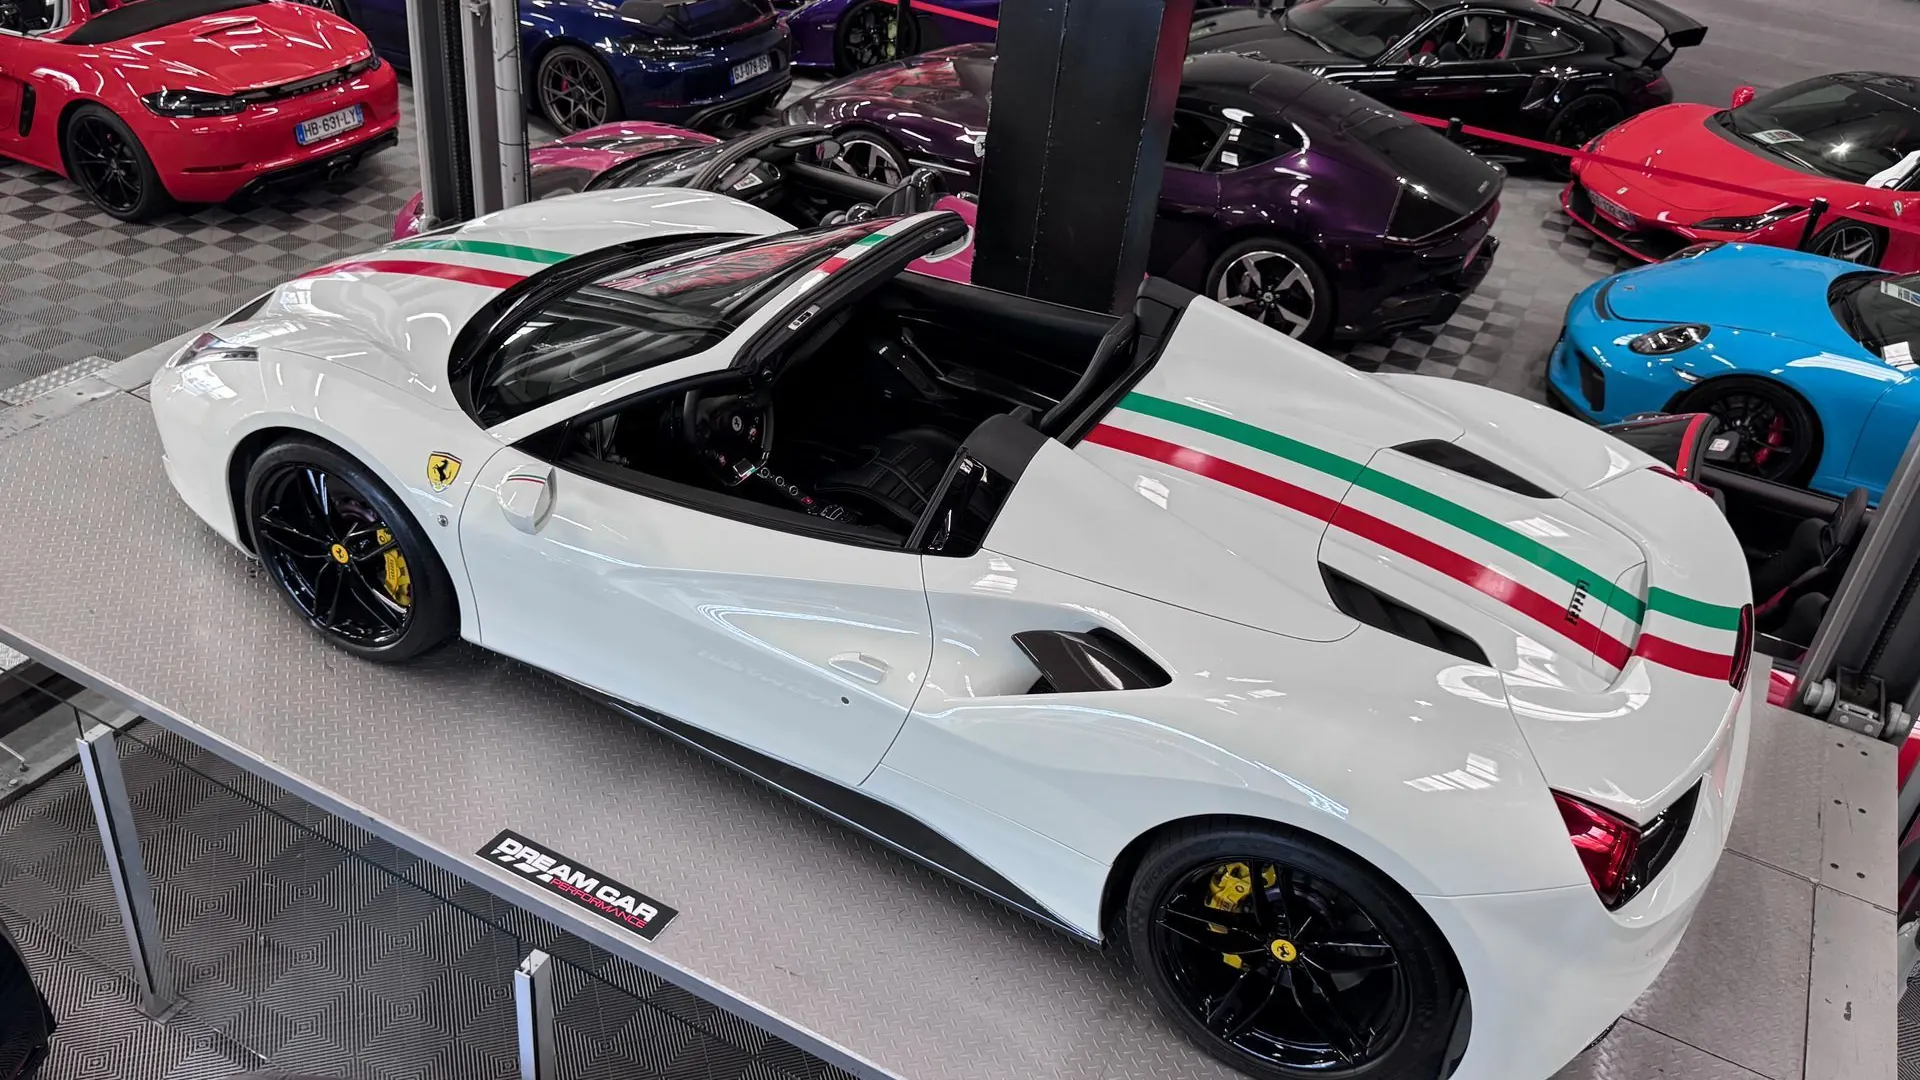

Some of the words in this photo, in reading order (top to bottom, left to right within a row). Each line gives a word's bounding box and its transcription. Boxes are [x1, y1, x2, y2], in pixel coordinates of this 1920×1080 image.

[303, 109, 356, 138] HB-631-LY
[496, 837, 600, 893] DREAM
[595, 885, 658, 922] CAR
[550, 877, 647, 929] PERFORMANCE
